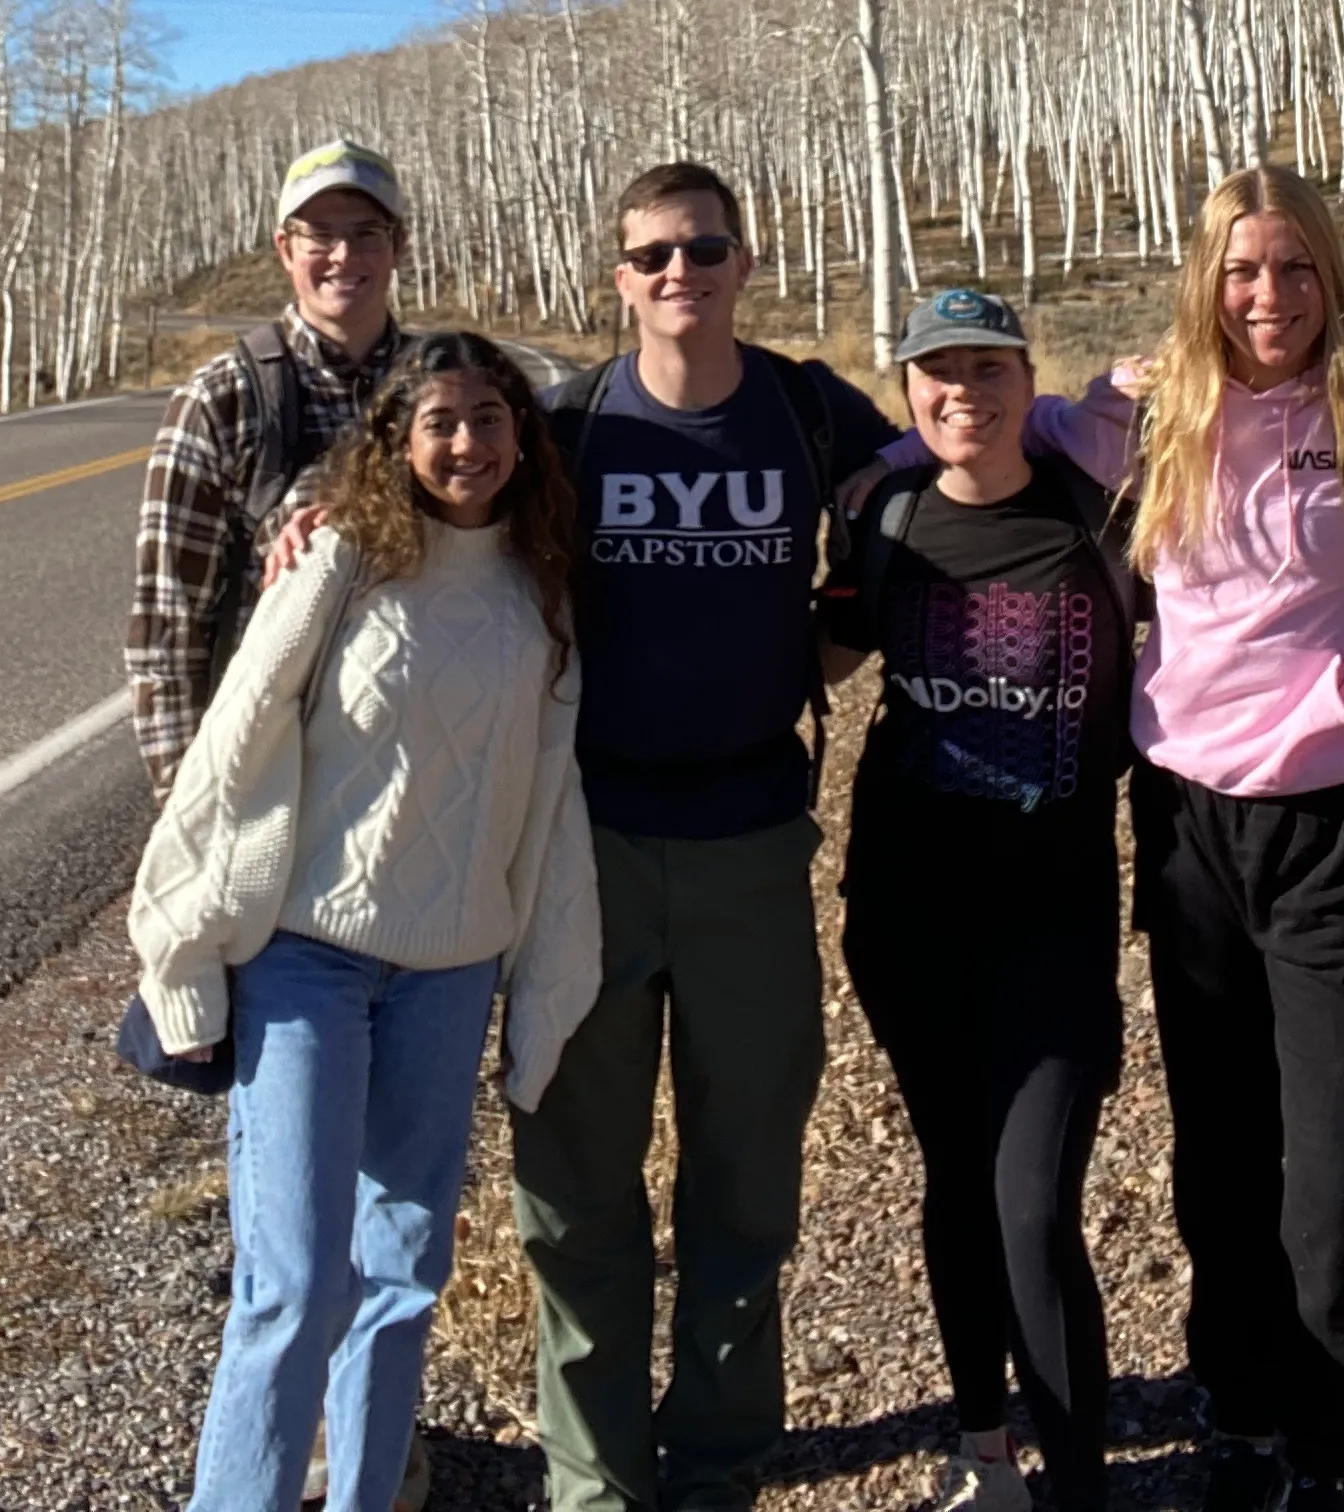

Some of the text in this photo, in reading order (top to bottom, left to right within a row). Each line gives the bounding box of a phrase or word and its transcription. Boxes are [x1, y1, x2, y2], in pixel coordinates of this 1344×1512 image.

[1280, 448, 1338, 471] NAS
[598, 468, 785, 530] BYU
[590, 536, 793, 568] CAPSTONE
[929, 675, 1088, 720] Dolby.io
